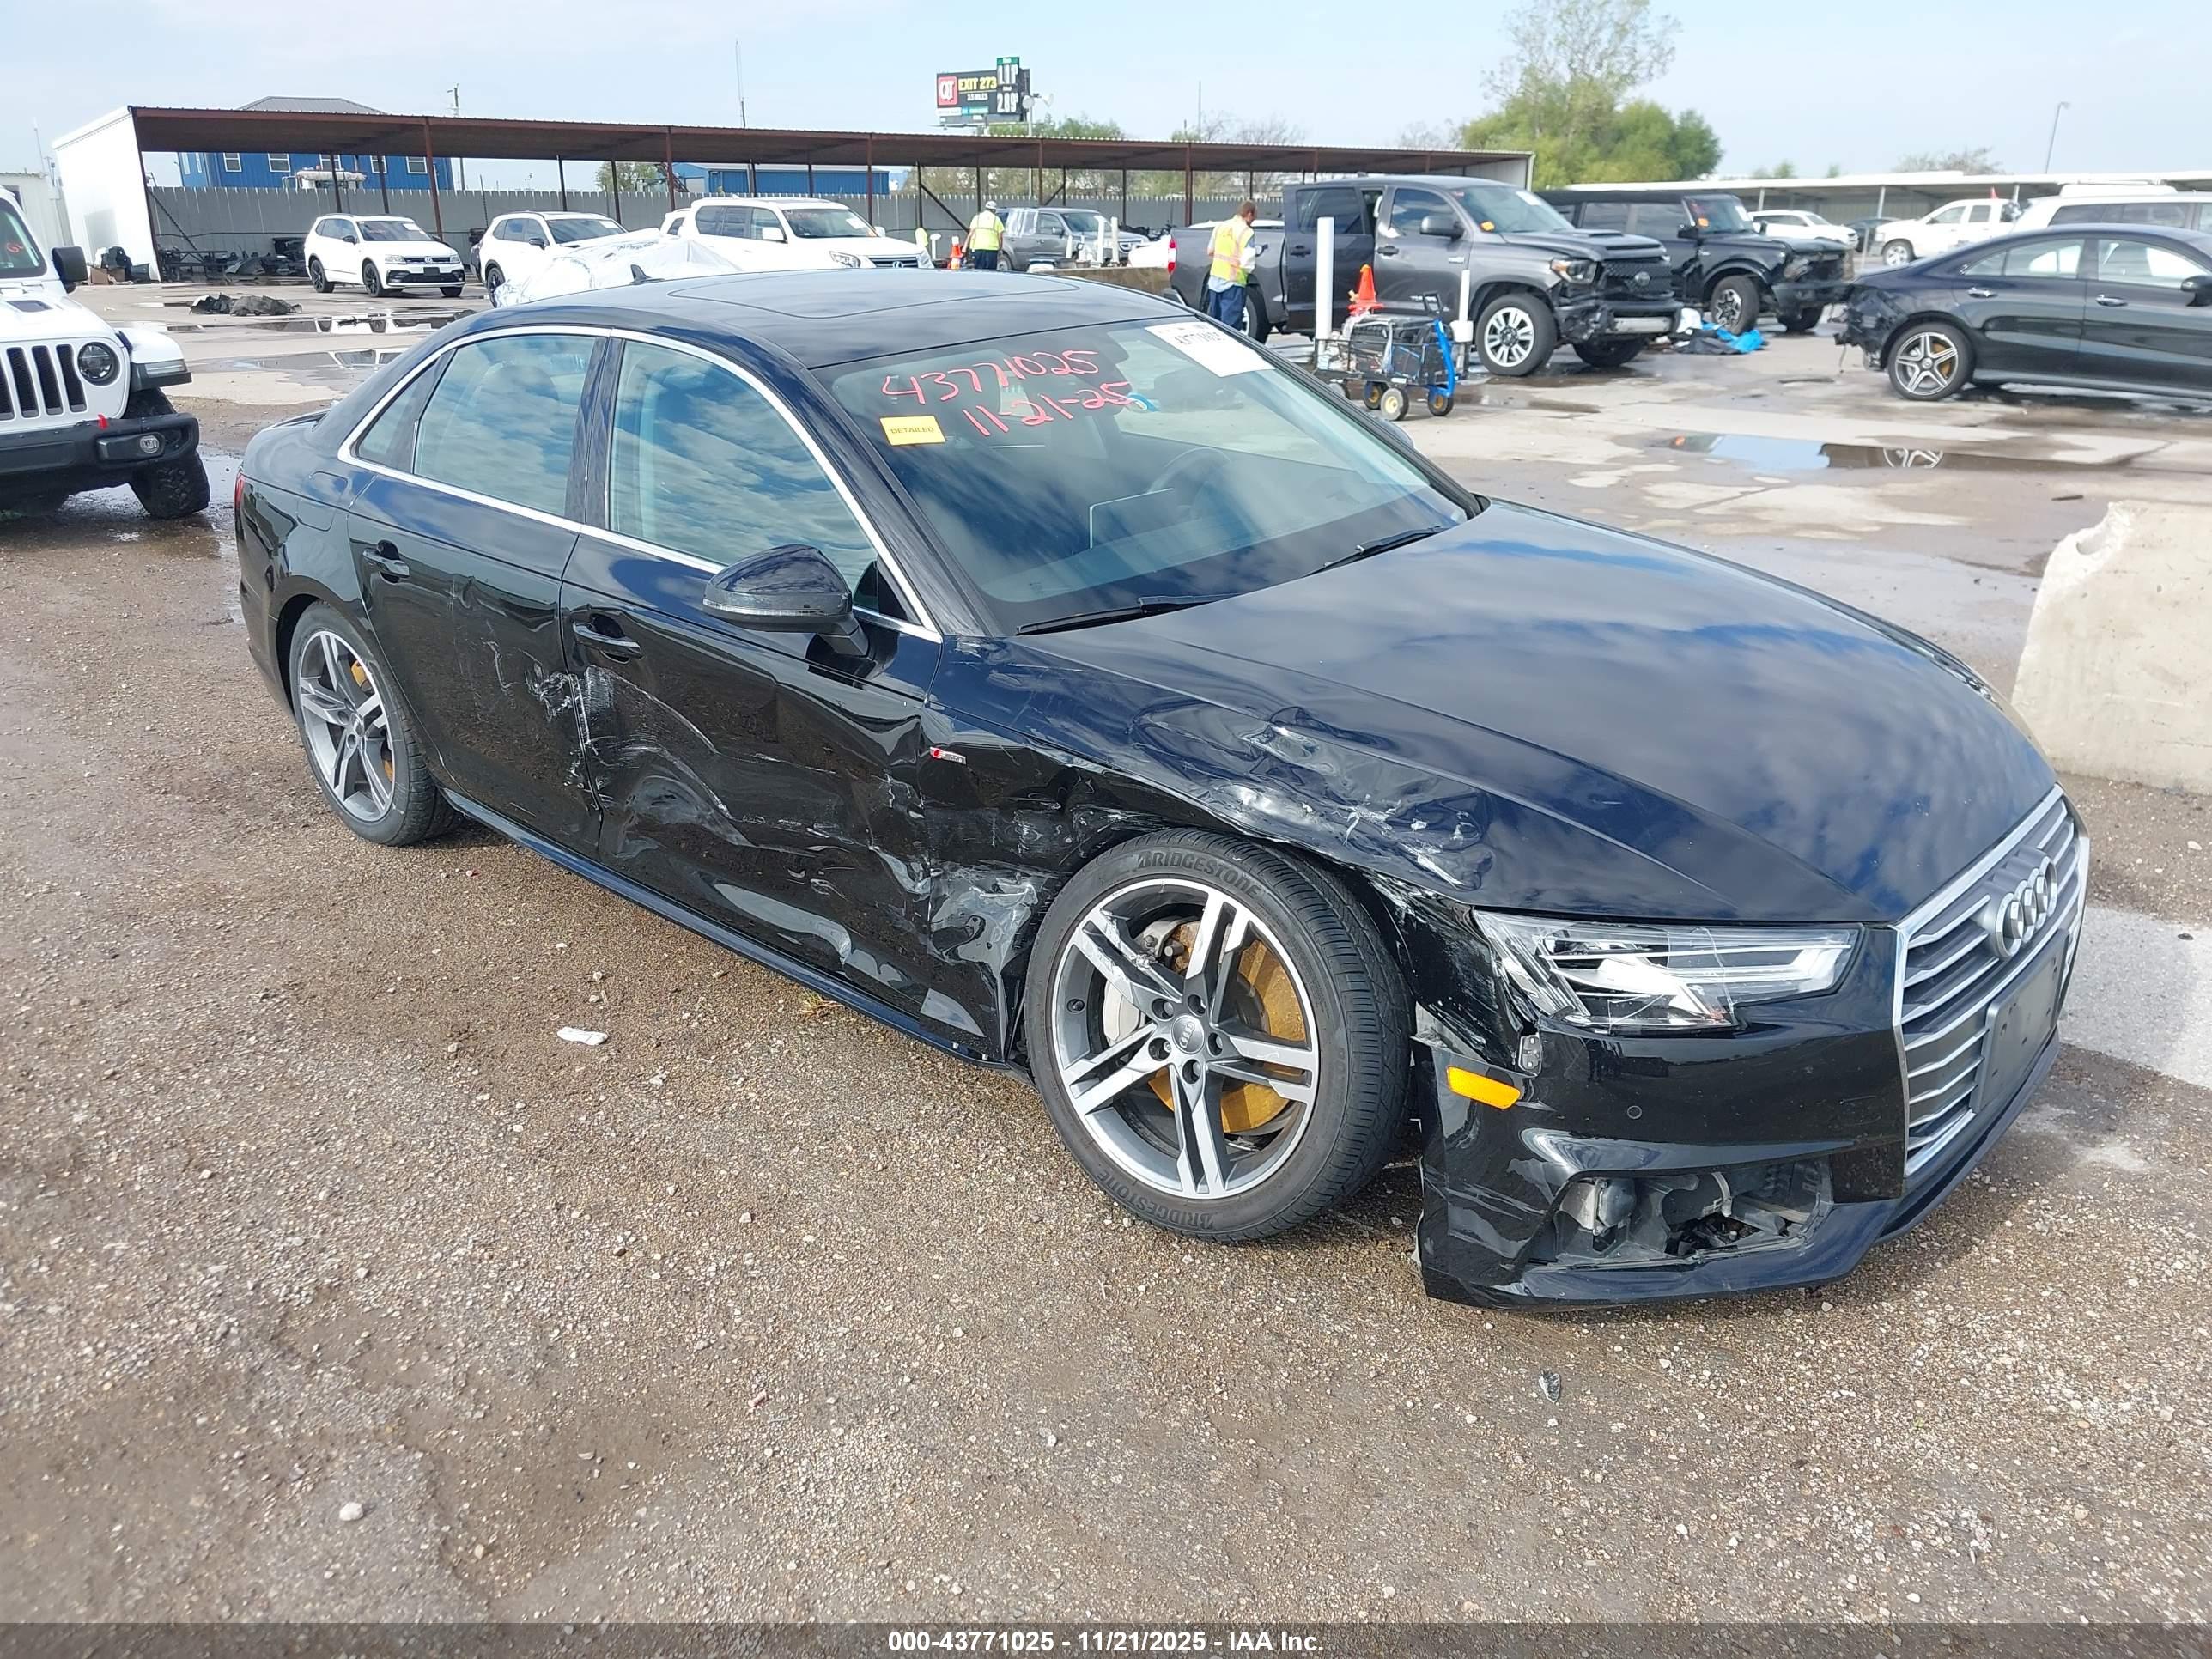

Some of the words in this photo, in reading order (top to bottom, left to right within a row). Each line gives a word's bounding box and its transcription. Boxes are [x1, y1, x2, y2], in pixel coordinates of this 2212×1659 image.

[939, 80, 955, 102] QT
[958, 78, 979, 91] EXIT
[979, 76, 997, 89] 273
[881, 350, 1099, 404] 43771025
[963, 381, 1135, 436] 11-21-25
[1138, 851, 1262, 899] BRIDGESTONE
[1097, 1170, 1214, 1230] BRIDGESTONE
